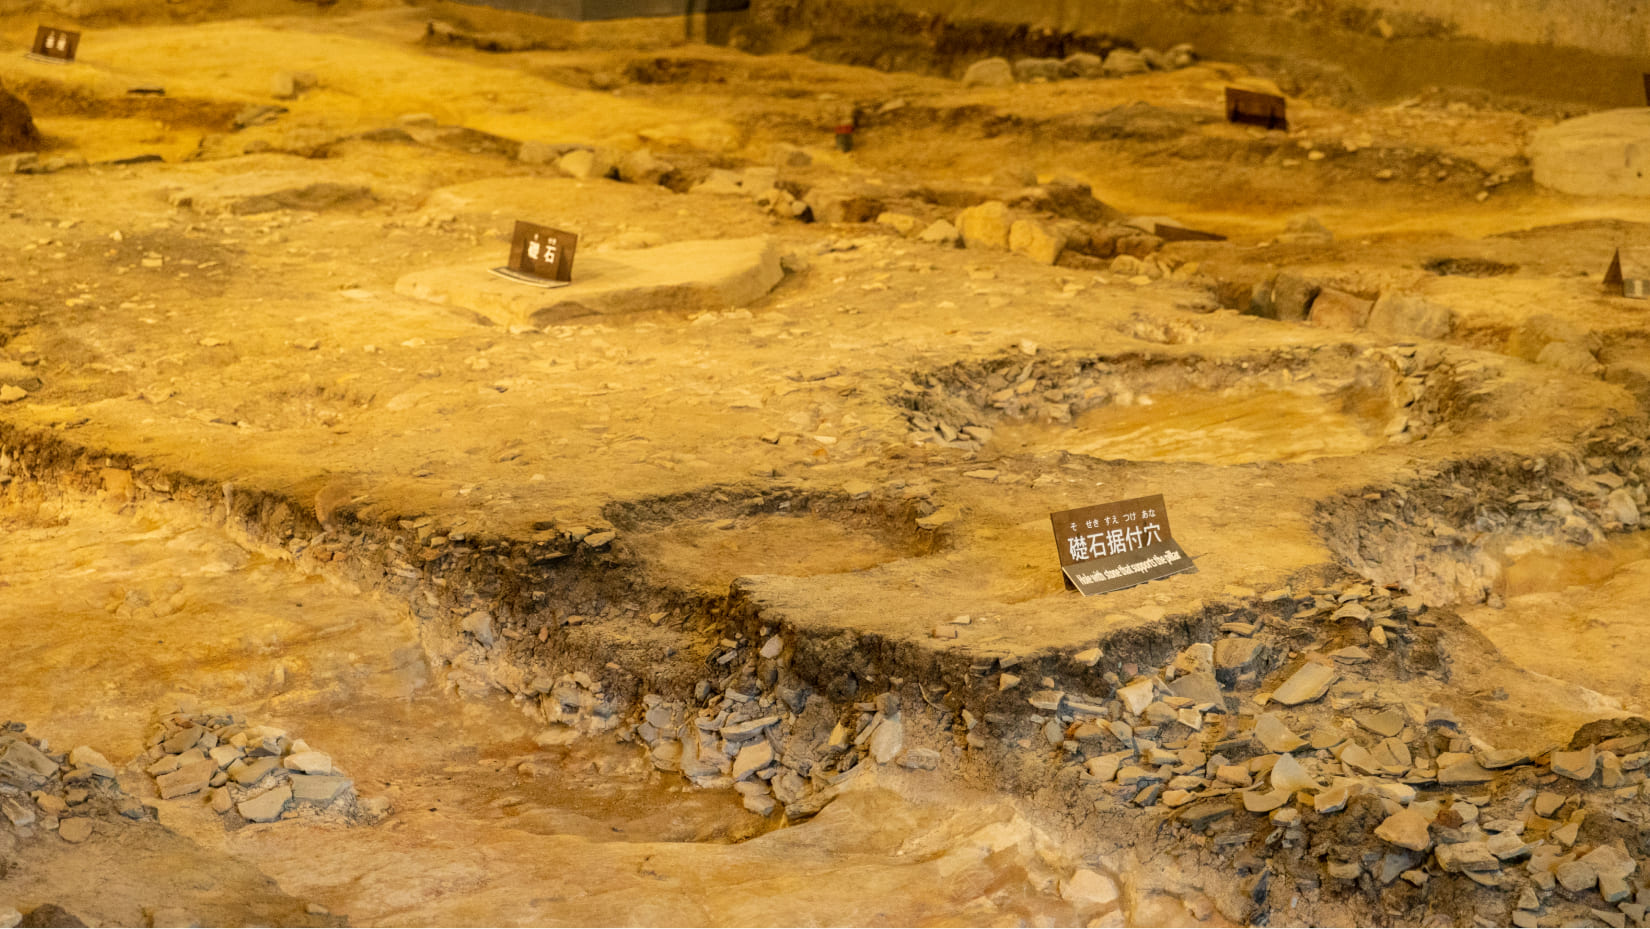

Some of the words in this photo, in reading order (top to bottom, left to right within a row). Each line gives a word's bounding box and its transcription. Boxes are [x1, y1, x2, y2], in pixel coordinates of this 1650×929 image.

[1071, 523, 1077, 532] そ
[1086, 519, 1099, 529] せき
[1104, 515, 1119, 526] すえ
[1122, 512, 1136, 521] つけ
[1141, 509, 1156, 519] あな
[1068, 523, 1162, 561] 礎石据付穴
[1075, 572, 1094, 585] Hole
[1089, 569, 1107, 583] with
[1104, 567, 1122, 580] stone
[1117, 562, 1134, 575] that
[1130, 558, 1158, 574] supports
[1151, 554, 1167, 566] the
